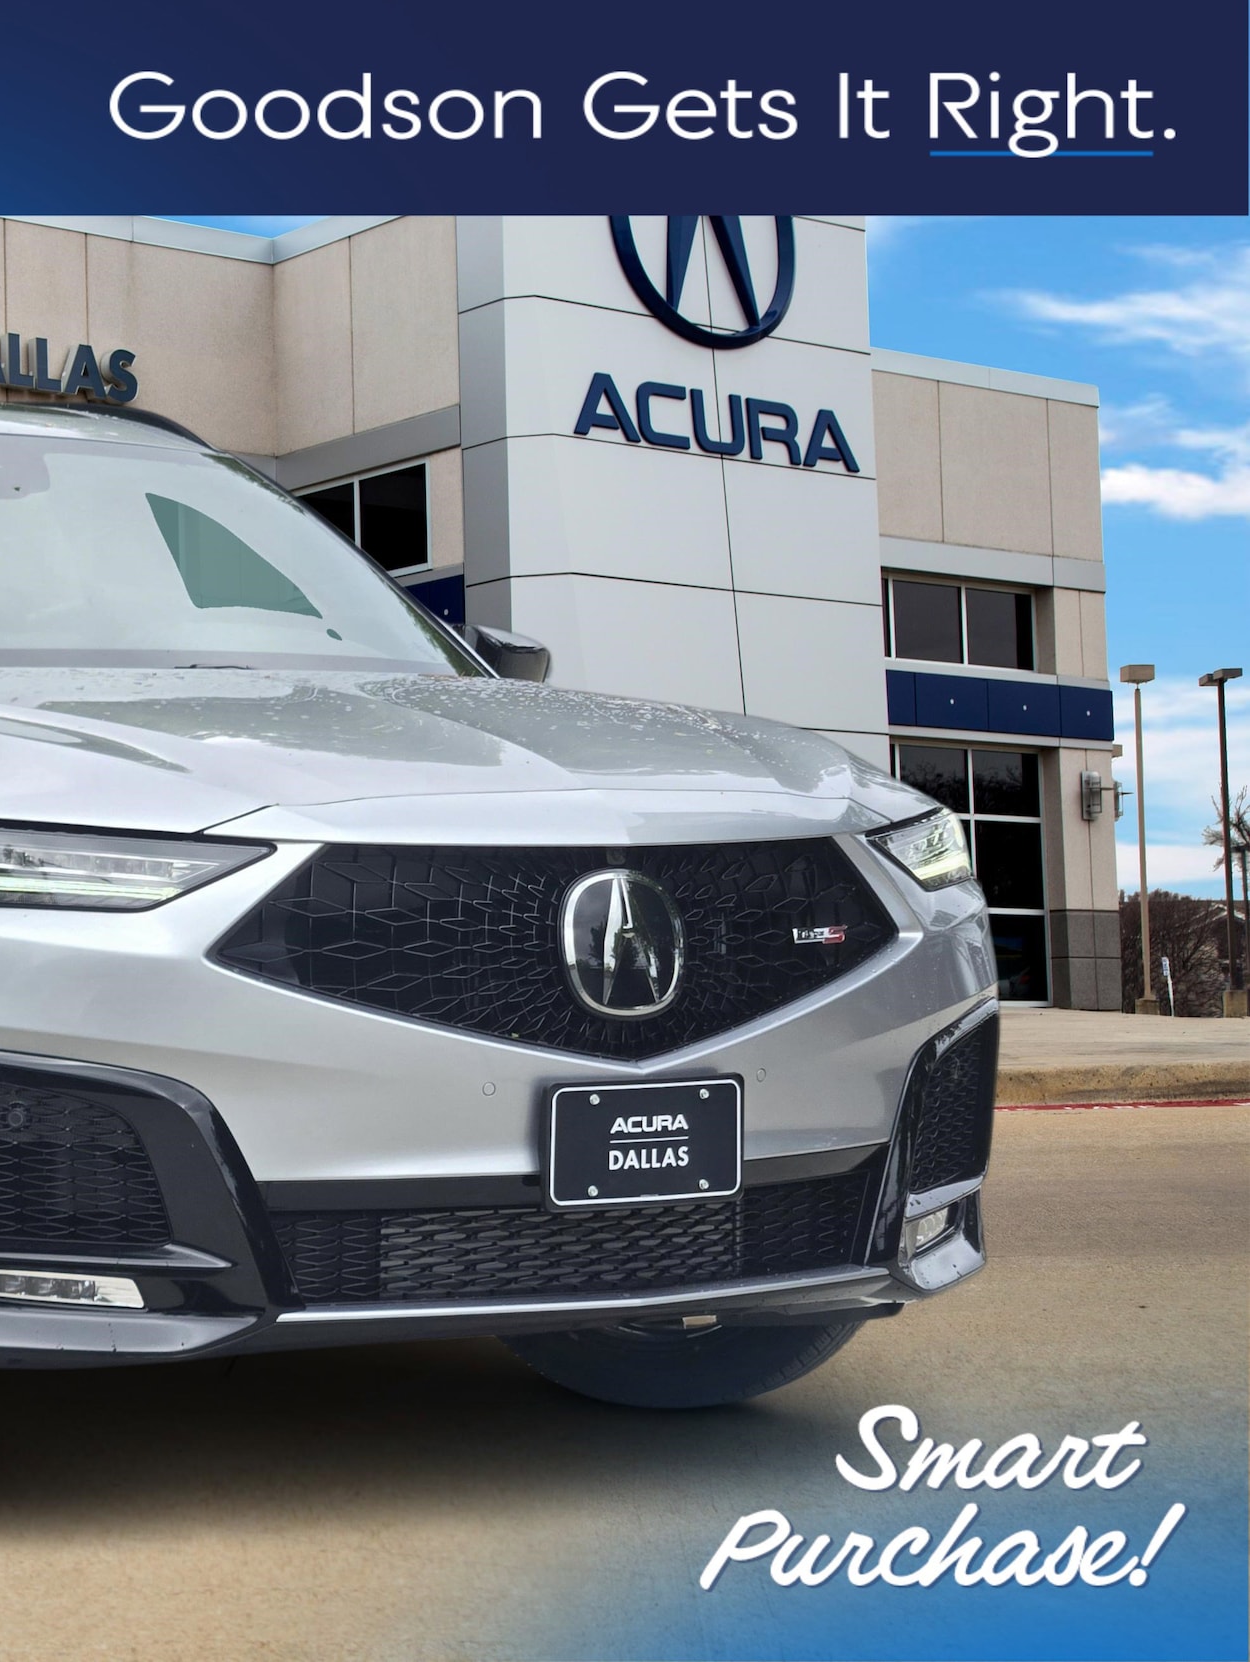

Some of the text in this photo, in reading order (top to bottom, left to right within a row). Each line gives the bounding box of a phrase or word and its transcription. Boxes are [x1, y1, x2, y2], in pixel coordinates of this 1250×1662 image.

[573, 372, 860, 473] ACURA
[610, 1114, 689, 1134] ACURA
[608, 1146, 690, 1171] DALLAS
